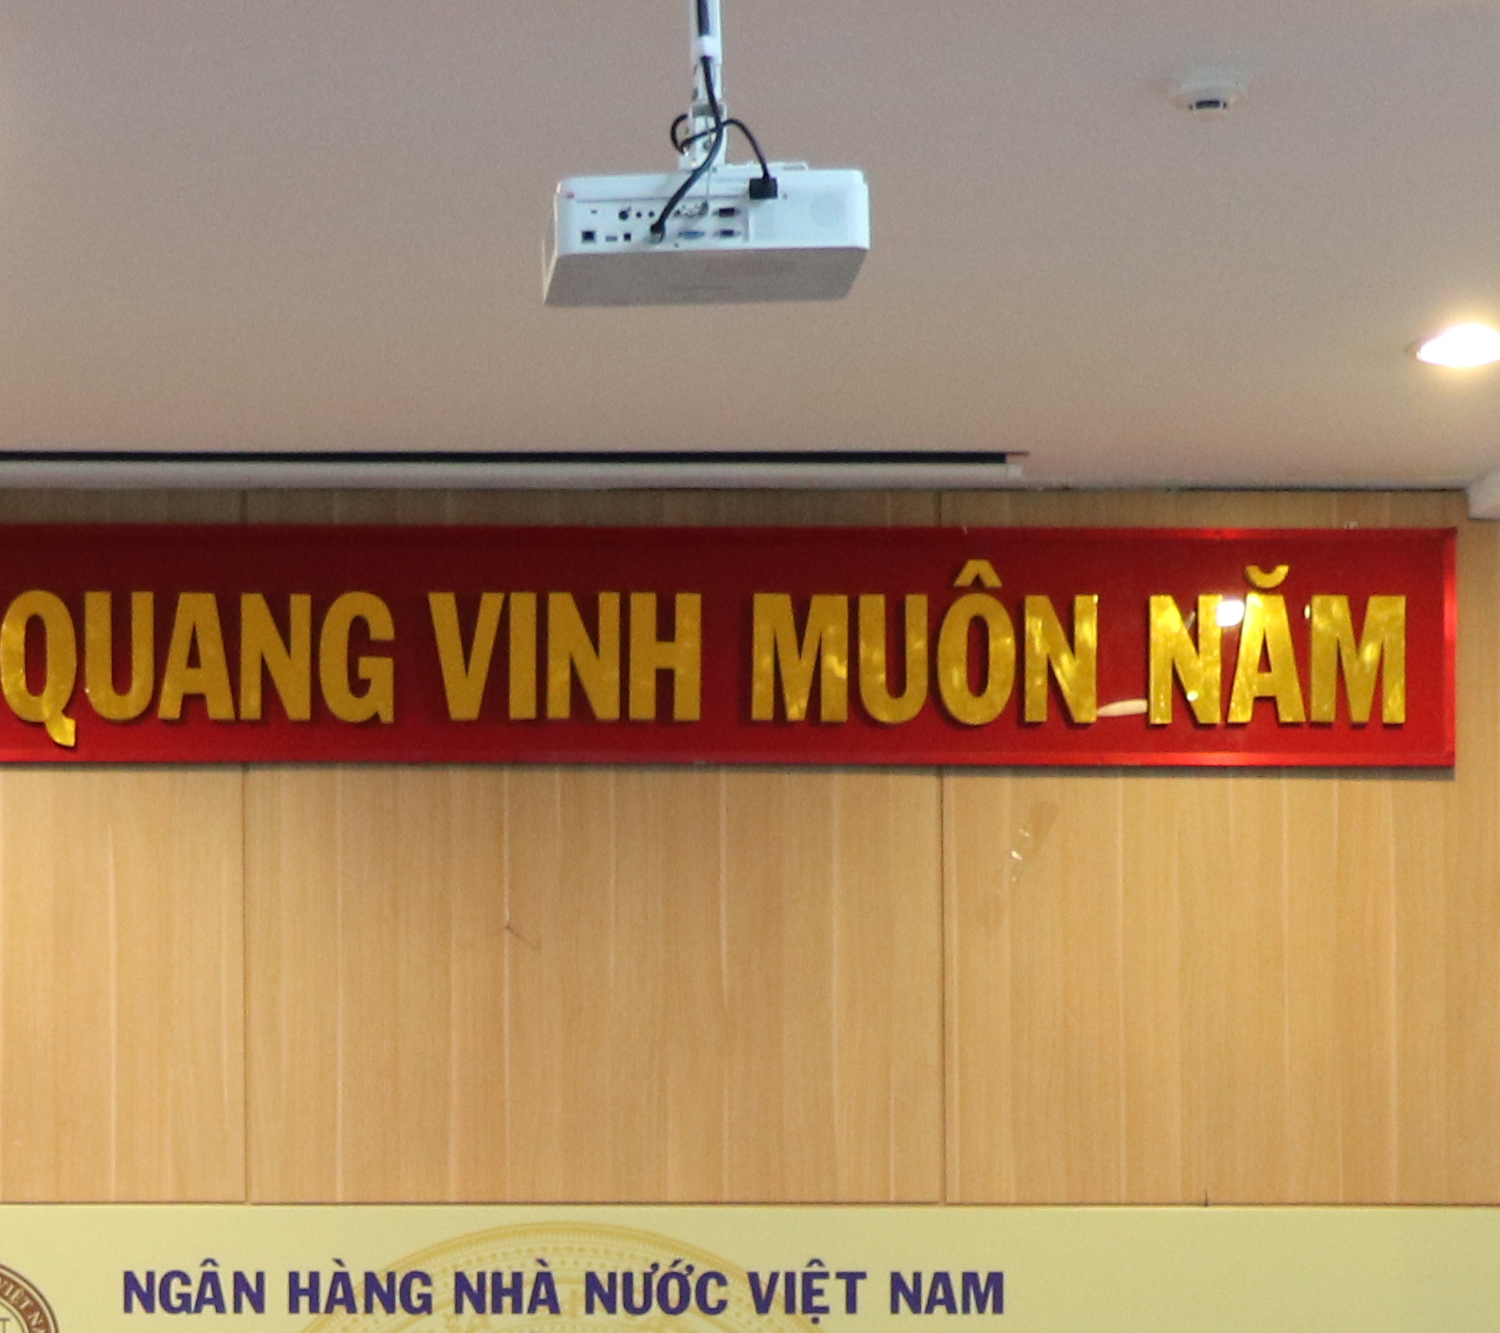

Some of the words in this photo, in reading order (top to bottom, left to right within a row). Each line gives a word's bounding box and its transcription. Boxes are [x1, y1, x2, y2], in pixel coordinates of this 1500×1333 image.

[430, 591, 702, 722] VINH
[752, 560, 1098, 726] MUÔN
[1148, 564, 1408, 728] NĂM
[122, 1259, 265, 1314] NGÂN
[288, 1258, 432, 1314] HÀNG
[454, 1258, 561, 1314] NHÀ
[585, 1258, 727, 1315] NƯỚC
[748, 1259, 868, 1324] VIỆT
[891, 1271, 1004, 1314] NAM
